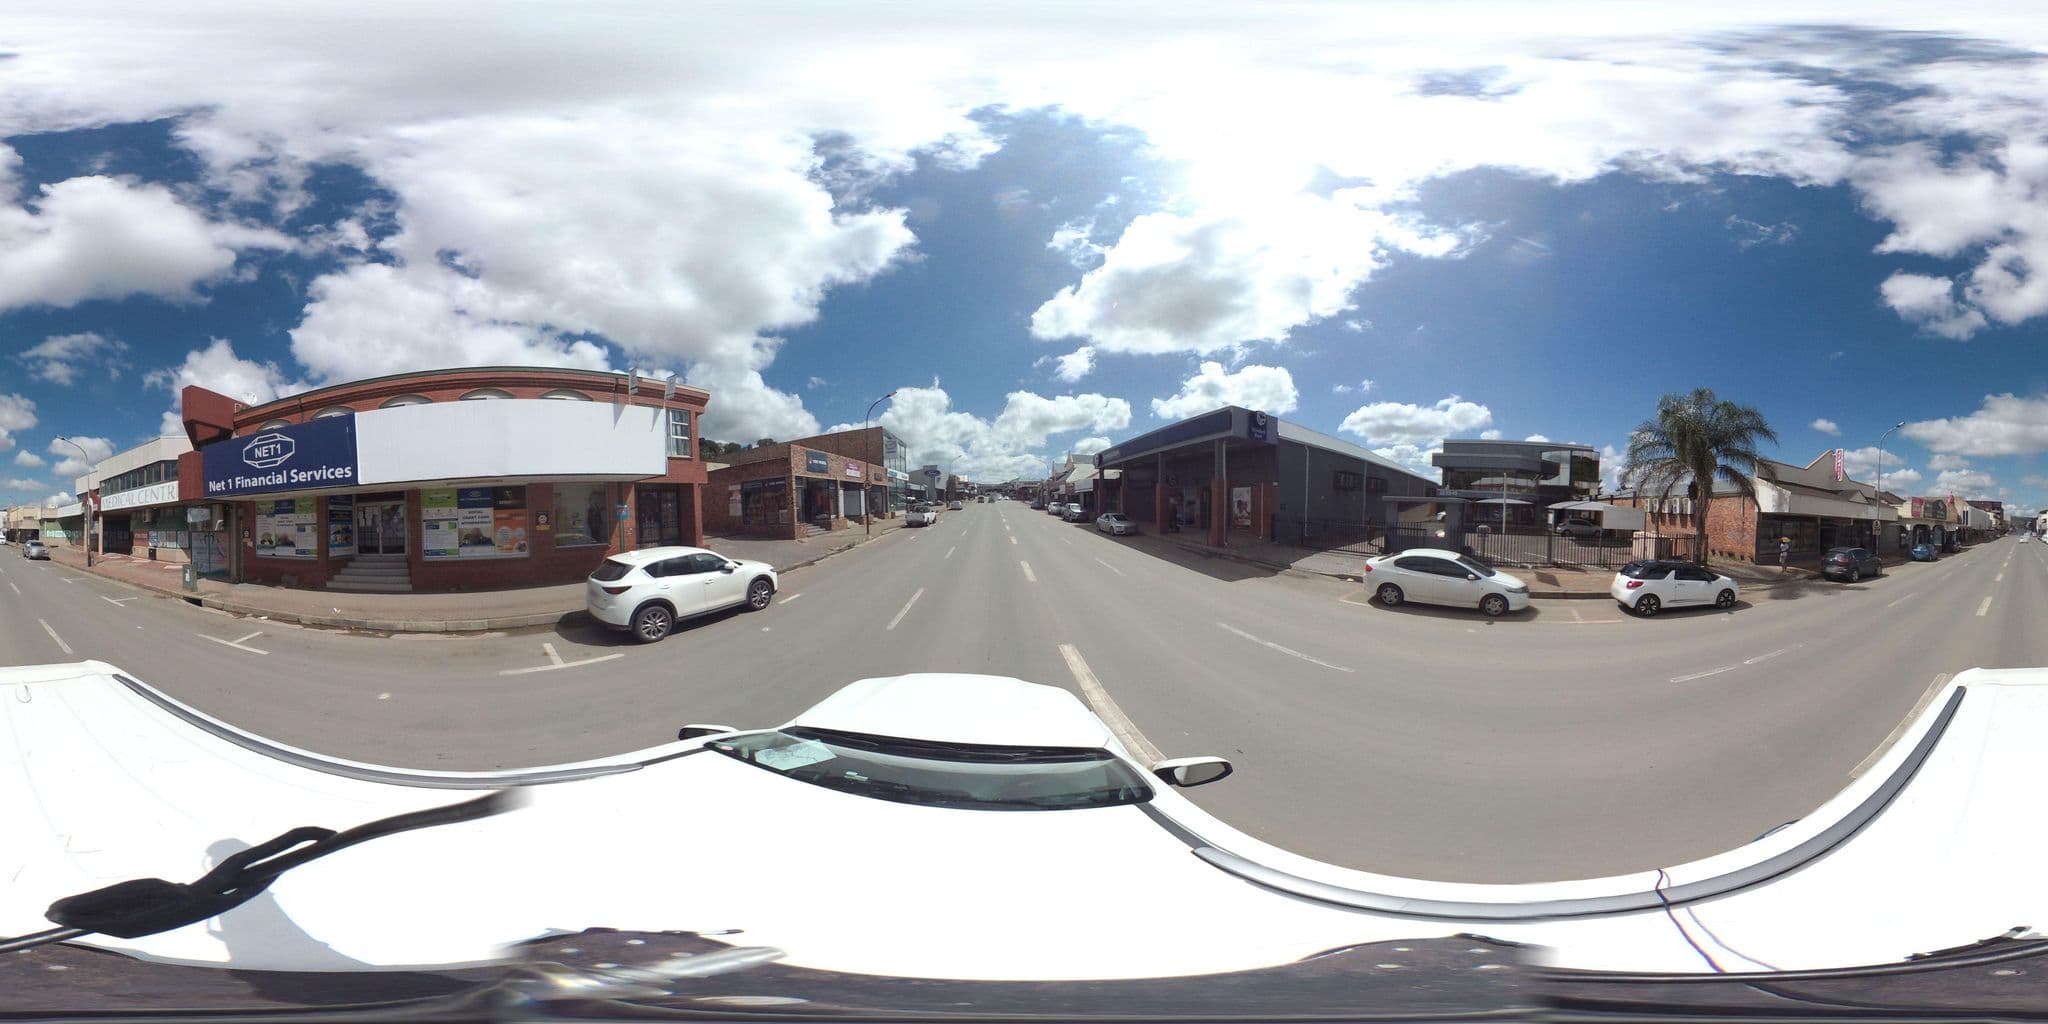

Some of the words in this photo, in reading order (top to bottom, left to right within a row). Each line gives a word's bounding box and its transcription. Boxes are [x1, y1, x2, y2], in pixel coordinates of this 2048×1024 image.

[255, 443, 281, 458] NET1
[209, 480, 225, 492] Net
[228, 478, 233, 489] 1
[237, 470, 287, 488] Financial
[290, 465, 352, 483] Services
